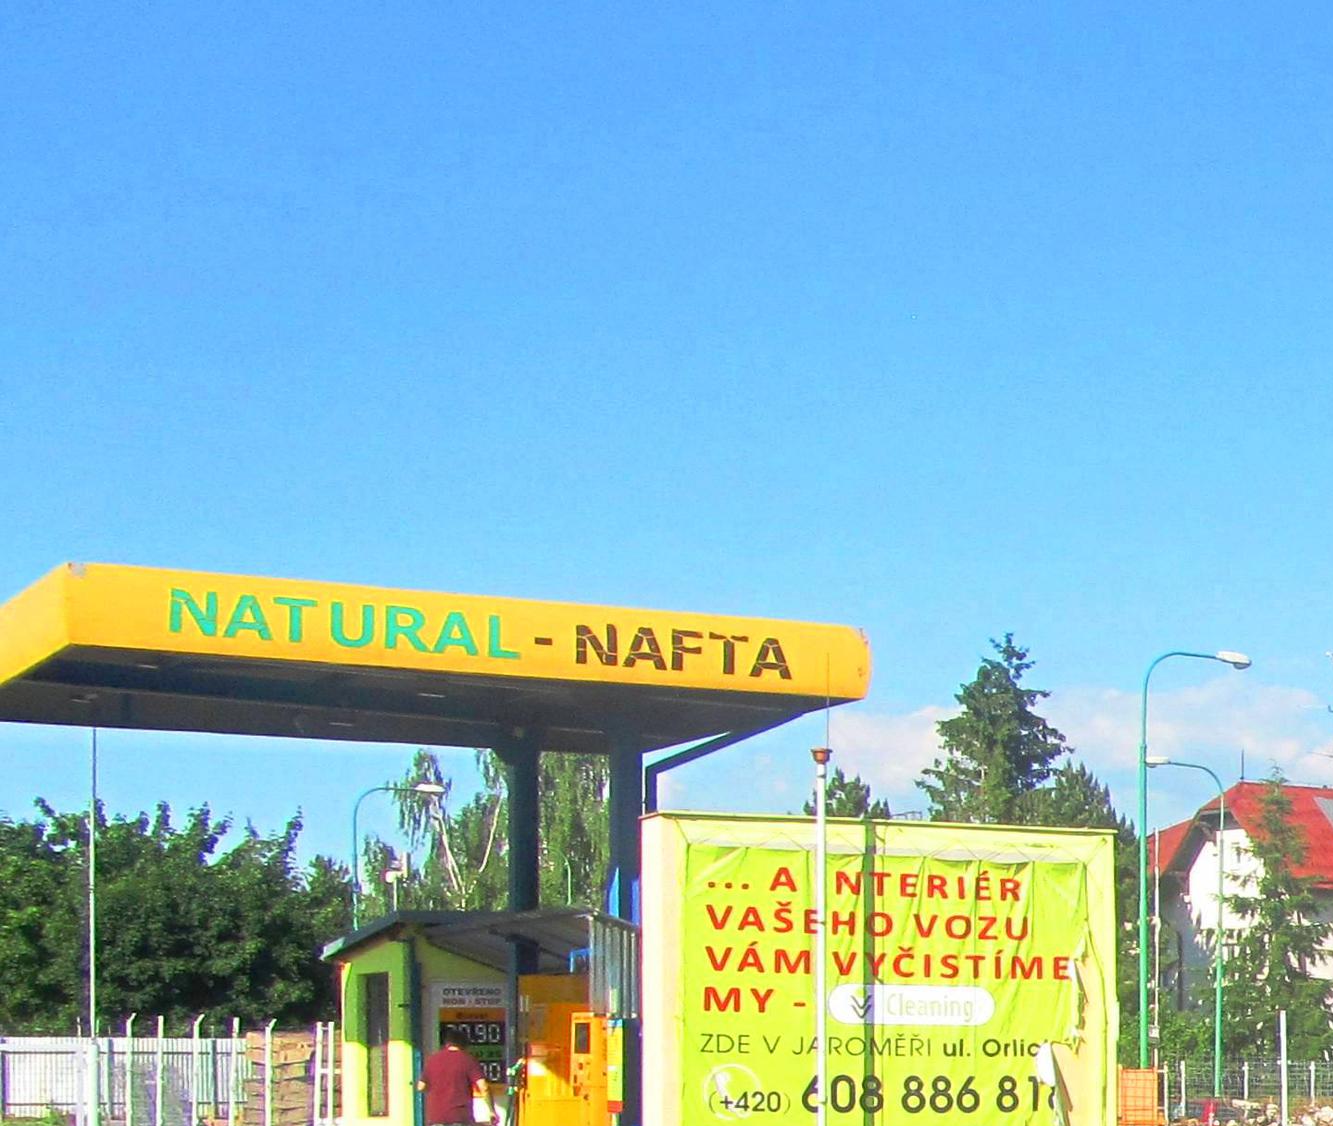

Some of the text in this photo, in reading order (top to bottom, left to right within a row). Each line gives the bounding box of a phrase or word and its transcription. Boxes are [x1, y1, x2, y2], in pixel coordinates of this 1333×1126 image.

[169, 587, 520, 660] NATURAL
[575, 623, 792, 680] NAFTA
[769, 867, 797, 892] A
[816, 870, 1021, 902] NTERIÉR
[705, 900, 1029, 941] VAŠEHO VOZU
[704, 940, 1071, 981] VÁM VYČISTÍME
[703, 986, 775, 1014] MY
[886, 992, 974, 1024] Cleaning
[700, 1033, 1049, 1058] ZDE V JAROMĚŘI ul. Orlic
[801, 1074, 884, 1114] 608
[901, 1075, 980, 1114] 886
